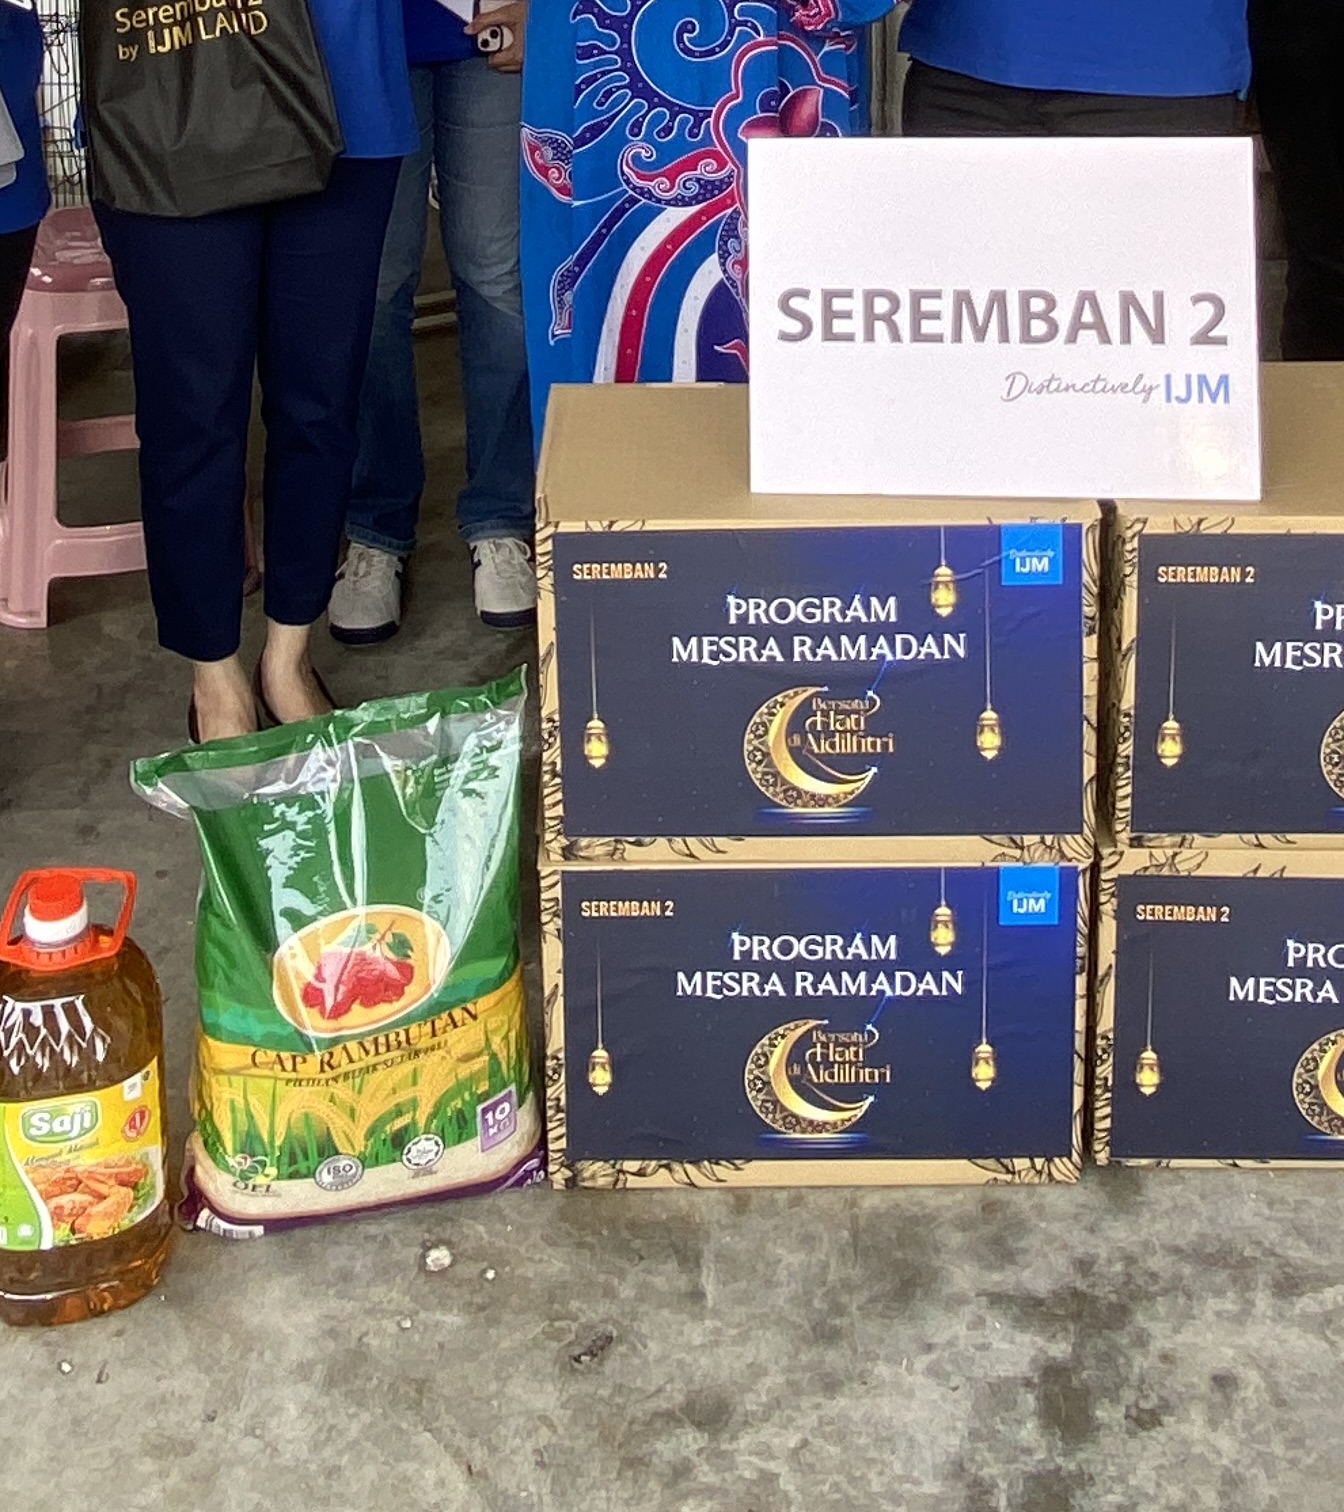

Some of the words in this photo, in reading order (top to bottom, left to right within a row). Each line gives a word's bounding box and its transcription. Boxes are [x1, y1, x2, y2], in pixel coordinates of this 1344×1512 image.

[117, 43, 139, 62] by
[147, 21, 194, 54] IJM
[776, 287, 1166, 346] SEREMBAN
[1188, 292, 1229, 346] 2
[1000, 370, 1161, 404] Distinctively
[1164, 373, 1231, 405] IJM
[572, 562, 654, 580] SEREMBAN
[657, 561, 668, 579] 2
[1015, 557, 1049, 574] IJM
[1157, 566, 1241, 583] SEREMBAN
[1244, 566, 1255, 583] 2
[728, 595, 897, 625] PROGRAM
[671, 635, 784, 666] MESRA
[792, 632, 968, 662] RAMADAN
[581, 900, 661, 917] SEREMBAN
[663, 899, 674, 917] 2
[1012, 898, 1046, 914] IJM
[1136, 904, 1217, 921] SEREMBAN
[1220, 905, 1231, 922] 2
[731, 933, 897, 960] PROGRAM
[675, 971, 787, 1000] MESRA
[794, 970, 964, 996] RAMADAN
[1228, 976, 1340, 1006] MESRA
[250, 1048, 307, 1073] CAP
[318, 1001, 479, 1074] RAMBUTAN
[29, 1104, 93, 1138] Saji
[485, 1101, 510, 1126] 10
[327, 1163, 354, 1176] ISO
